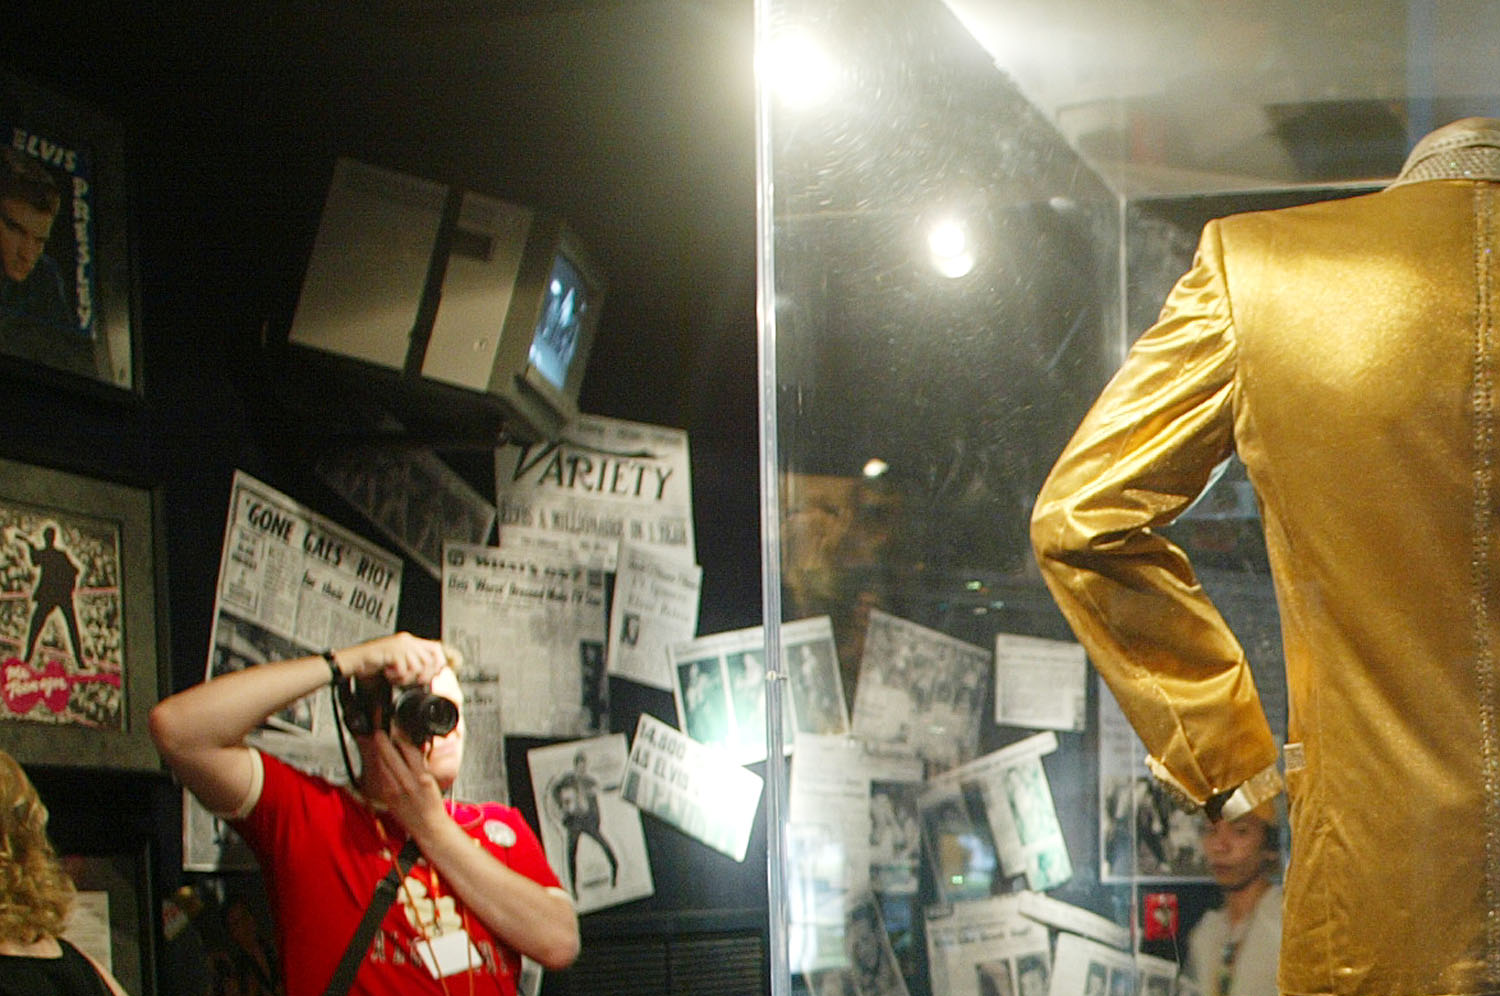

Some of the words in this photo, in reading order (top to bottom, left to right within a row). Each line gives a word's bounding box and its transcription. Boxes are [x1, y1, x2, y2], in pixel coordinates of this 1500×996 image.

[13, 127, 77, 173] ELVIS
[72, 175, 93, 330] PRESLEY
[505, 440, 673, 500] VARIETY
[356, 555, 395, 592] RIOT
